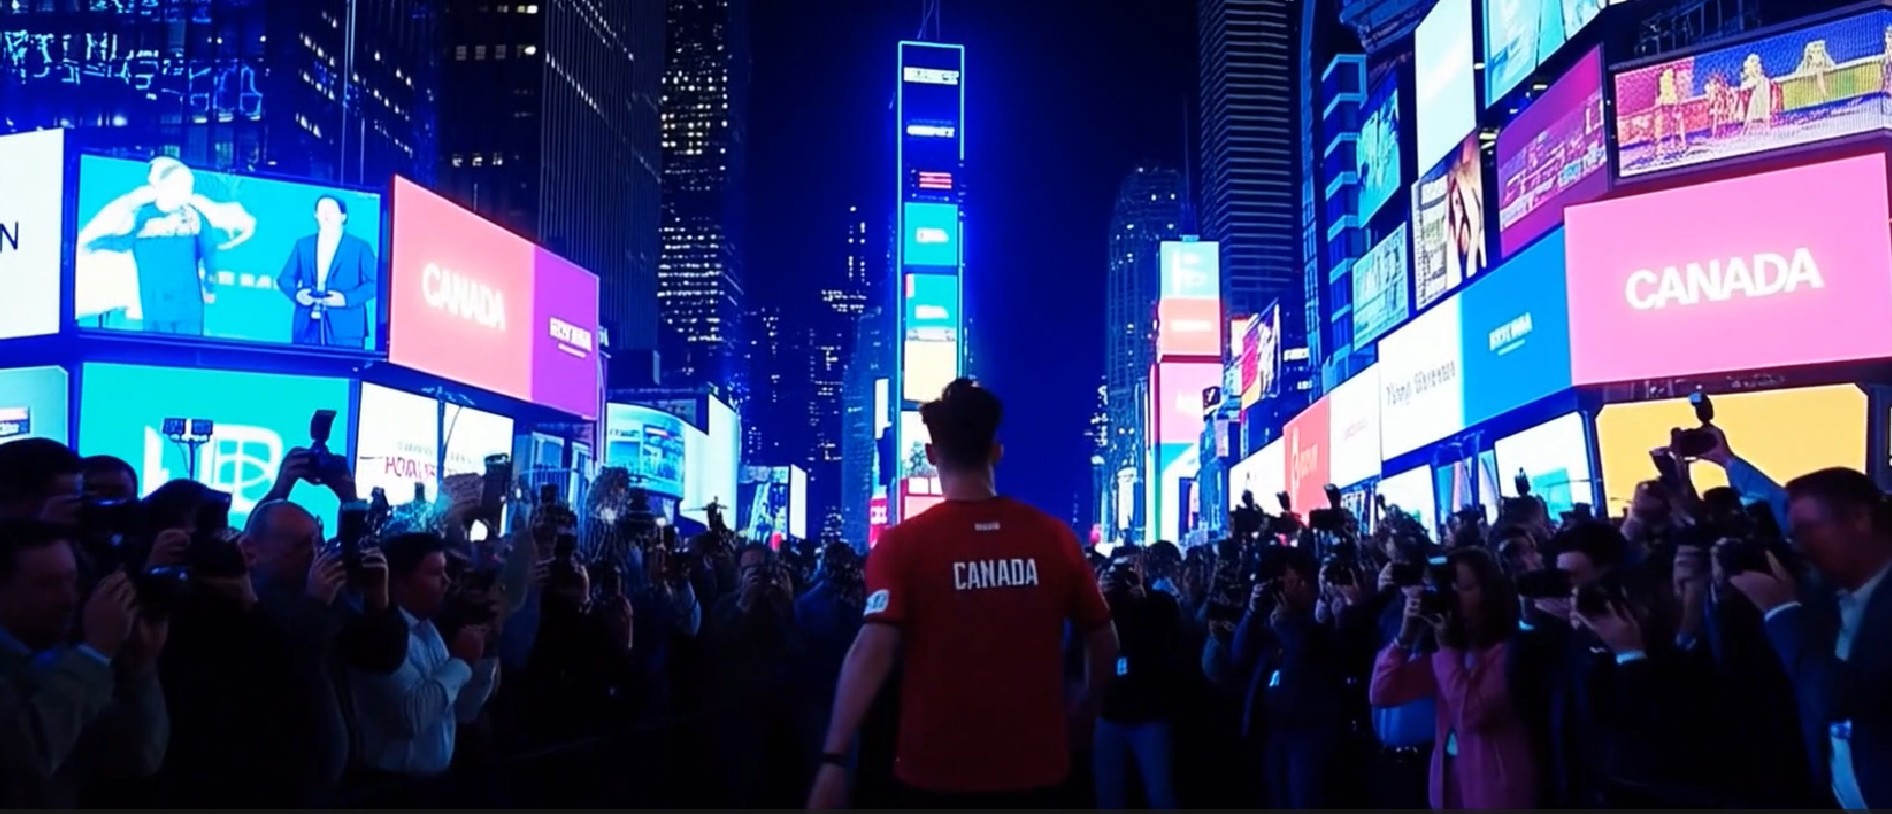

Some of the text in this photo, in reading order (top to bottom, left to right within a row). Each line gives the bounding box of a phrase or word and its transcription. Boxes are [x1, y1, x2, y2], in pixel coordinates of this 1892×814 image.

[422, 261, 507, 333] CANADA
[1624, 247, 1825, 310] CANADA
[953, 558, 1039, 590] CANADA
